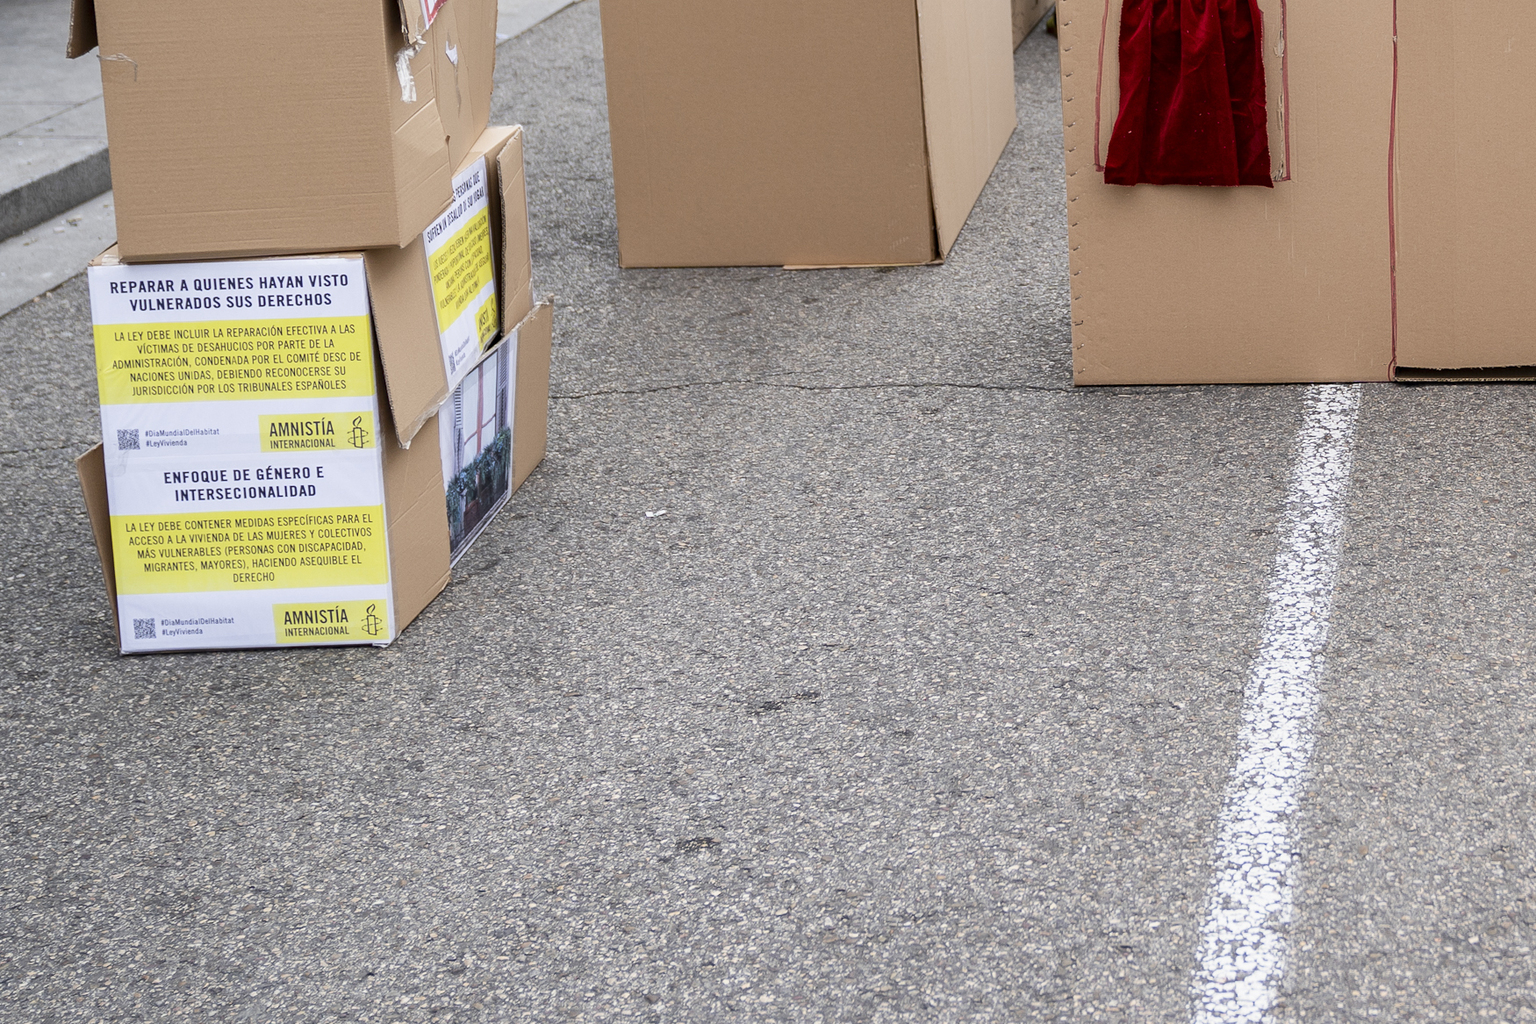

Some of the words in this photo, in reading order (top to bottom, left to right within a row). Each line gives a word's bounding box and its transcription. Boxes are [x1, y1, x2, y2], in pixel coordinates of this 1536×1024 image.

[110, 279, 175, 294] REPARAR
[180, 280, 188, 291] A
[193, 277, 253, 291] QUIENES
[259, 276, 303, 289] HAYAN
[308, 274, 348, 287] VISTO
[129, 296, 221, 312] VULNERADOS
[226, 296, 252, 308] SUS
[258, 293, 332, 307] DERECHOS
[114, 331, 125, 342] LA
[127, 331, 143, 341] LEY
[147, 330, 171, 340] DEBE
[174, 328, 210, 340] INCLUIR
[213, 328, 224, 338] LA
[226, 325, 283, 338] REPARACIÓN
[286, 325, 328, 337] EFECTIVA
[330, 325, 337, 335] A
[339, 324, 355, 334] LAS
[137, 342, 179, 354] VÍCTIMAS
[182, 343, 194, 353] DE
[197, 341, 253, 353] DESAHUCIOS
[257, 340, 275, 351] POR
[278, 339, 306, 350] PARTE
[309, 339, 321, 349] DE
[324, 339, 334, 348] LA
[112, 355, 192, 369] ADMINISTRACIÓN,
[194, 354, 249, 367] CONDENADA
[252, 354, 270, 364] POR
[273, 353, 283, 363] EL
[287, 351, 320, 363] COMITÉ
[323, 352, 347, 362] DESC
[350, 351, 361, 361] DE
[130, 371, 175, 382] NACIONES
[178, 370, 214, 382] UNIDAS,
[217, 368, 262, 380] DEBIENDO
[265, 367, 331, 378] RECONOCERSE
[334, 366, 346, 376] SU
[132, 383, 194, 396] JURISDICCIÓN
[197, 383, 215, 394] POR
[218, 382, 235, 393] LOS
[238, 381, 293, 393] TRIBUNALES
[296, 378, 346, 391] ESPAÑOLES
[269, 417, 335, 437] AMNISTÍA
[146, 439, 188, 448] #LeyVivienda
[270, 438, 336, 449] INTERNACIONAL
[164, 469, 228, 484] ENFOQUE
[233, 469, 250, 481] DE
[256, 465, 311, 480] GÉNERO
[316, 466, 324, 478] E
[175, 484, 316, 502] INTERSECIONALIDAD
[125, 523, 136, 533] LA
[139, 522, 155, 532] LEY
[158, 521, 182, 532] DEBE
[184, 519, 232, 531] CONTENER
[235, 517, 275, 528] MEDIDAS
[277, 514, 334, 527] ESPECÍFICAS
[337, 514, 359, 525] PARA
[362, 514, 373, 523] EL
[129, 535, 164, 546] ACCESO
[167, 535, 173, 544] A
[176, 534, 187, 544] LA
[190, 532, 230, 544] VIVIENDA
[233, 532, 244, 542] DE
[247, 531, 264, 542] LAS
[266, 529, 307, 541] MUJERES
[309, 529, 315, 538] Y
[317, 527, 372, 538] COLECTIVOS
[137, 546, 156, 559] MÁS
[159, 546, 221, 558] VULNERABLES
[224, 543, 274, 557] (PERSONAS
[277, 543, 296, 554] CON
[298, 541, 366, 553] DISCAPACIDAD,
[143, 561, 198, 573] MIGRANTES,
[200, 558, 249, 571] MAYORES),
[252, 557, 297, 569] HACIENDO
[300, 555, 348, 567] ASEQUIBLE
[351, 555, 362, 565] EL
[233, 571, 275, 584] DERECHO
[284, 606, 349, 625] AMNISTÍA
[161, 627, 203, 637] #LeyVivienda
[284, 626, 349, 637] INTERNACIONAL
